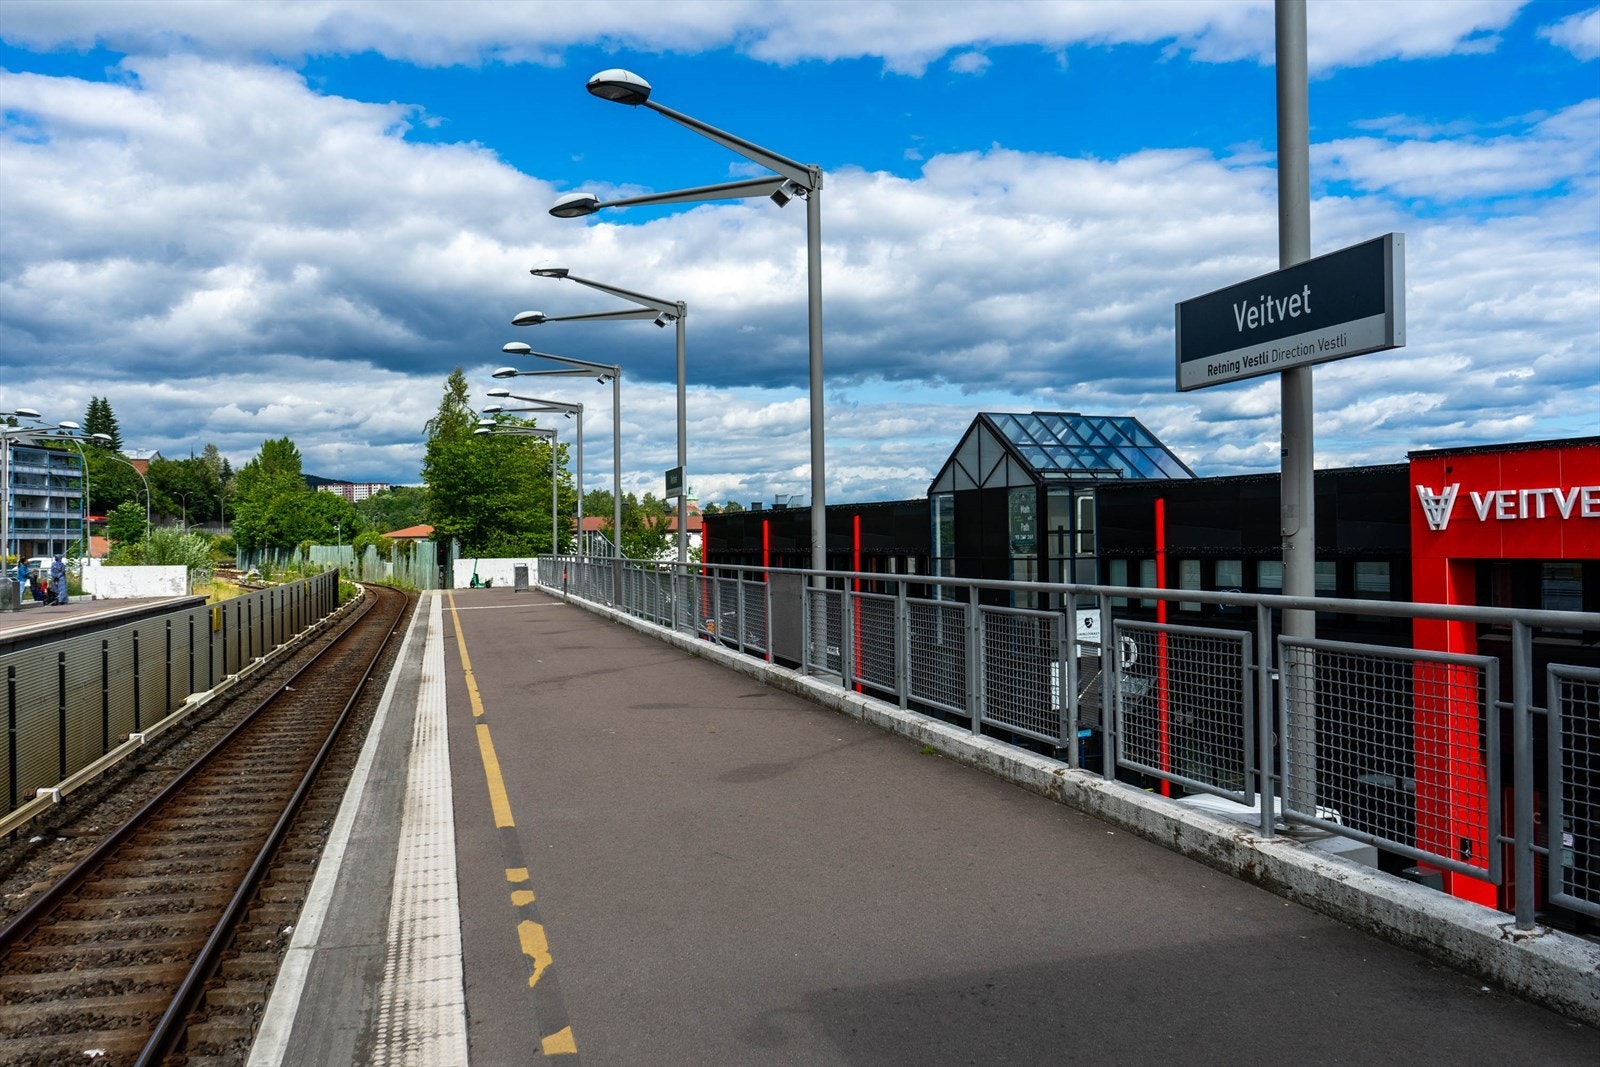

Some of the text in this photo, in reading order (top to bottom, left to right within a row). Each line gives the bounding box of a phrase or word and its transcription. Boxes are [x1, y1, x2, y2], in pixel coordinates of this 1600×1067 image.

[1233, 284, 1311, 332] Veitvet
[1207, 333, 1347, 376] Retning Vestli Direction Vestli
